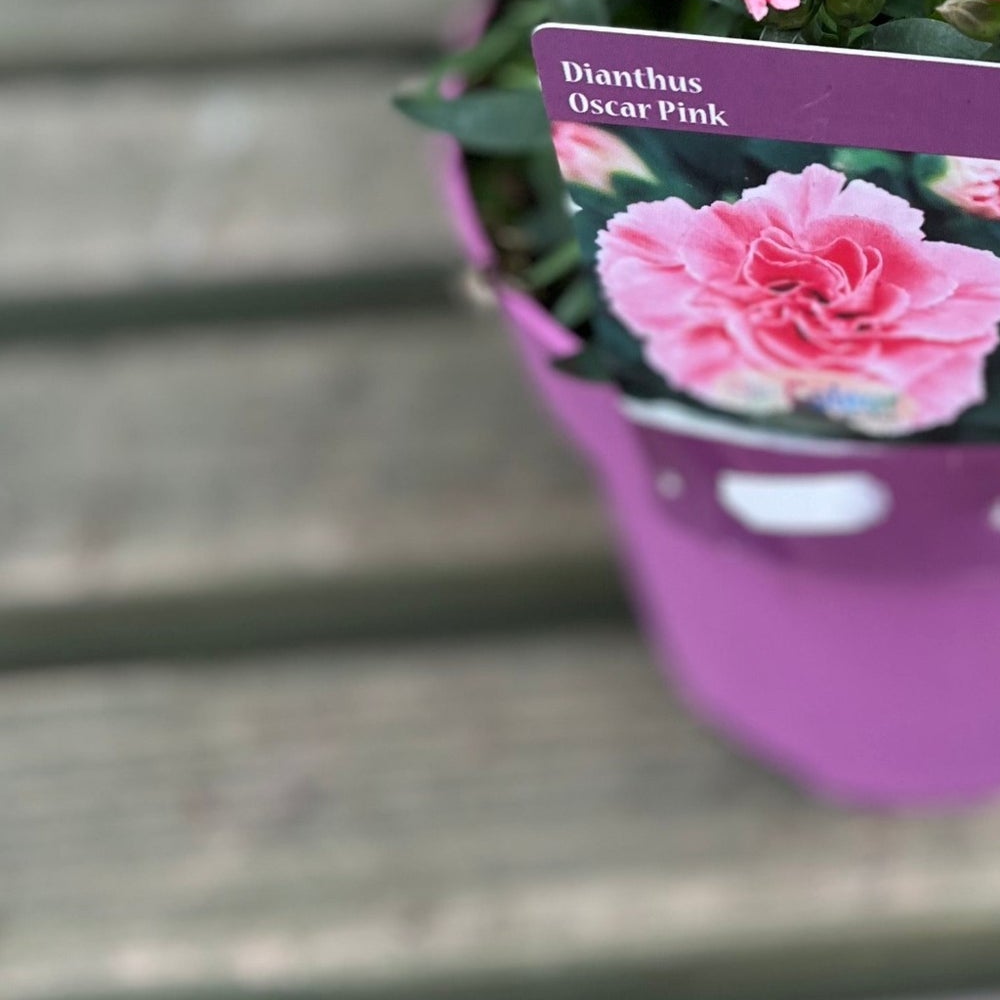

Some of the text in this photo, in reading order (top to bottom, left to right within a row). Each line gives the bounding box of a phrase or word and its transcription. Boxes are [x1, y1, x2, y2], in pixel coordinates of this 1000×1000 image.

[560, 60, 703, 94] Dianthus
[568, 92, 729, 127] Oscar Pink
